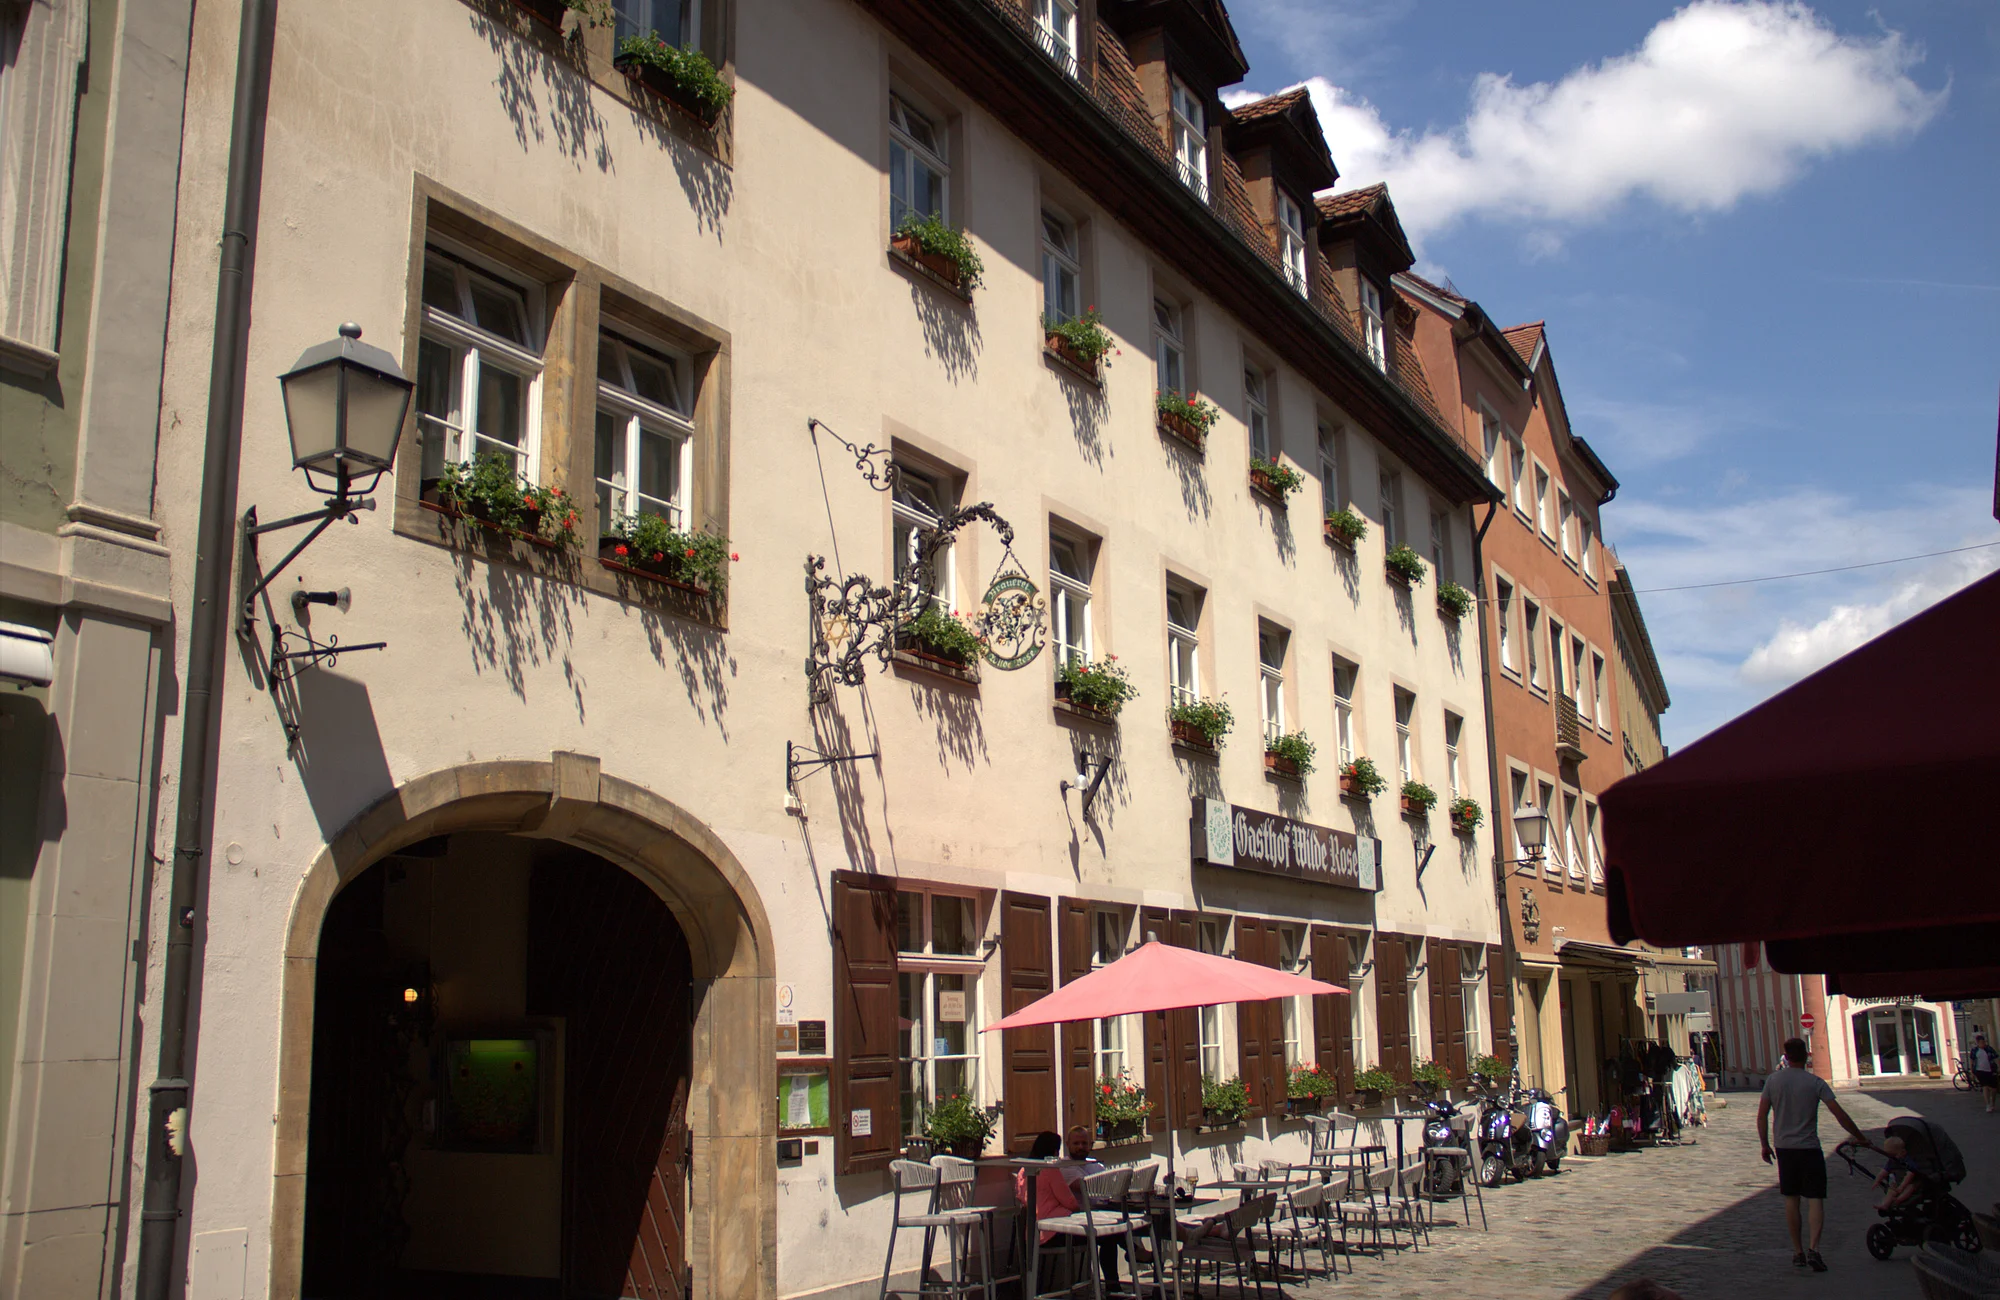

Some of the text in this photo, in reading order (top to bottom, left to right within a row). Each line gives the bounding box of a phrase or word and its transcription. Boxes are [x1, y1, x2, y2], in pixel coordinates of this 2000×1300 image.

[1232, 811, 1290, 869] Gasthof
[1292, 825, 1328, 872] Wilde
[1329, 834, 1359, 878] Rose
